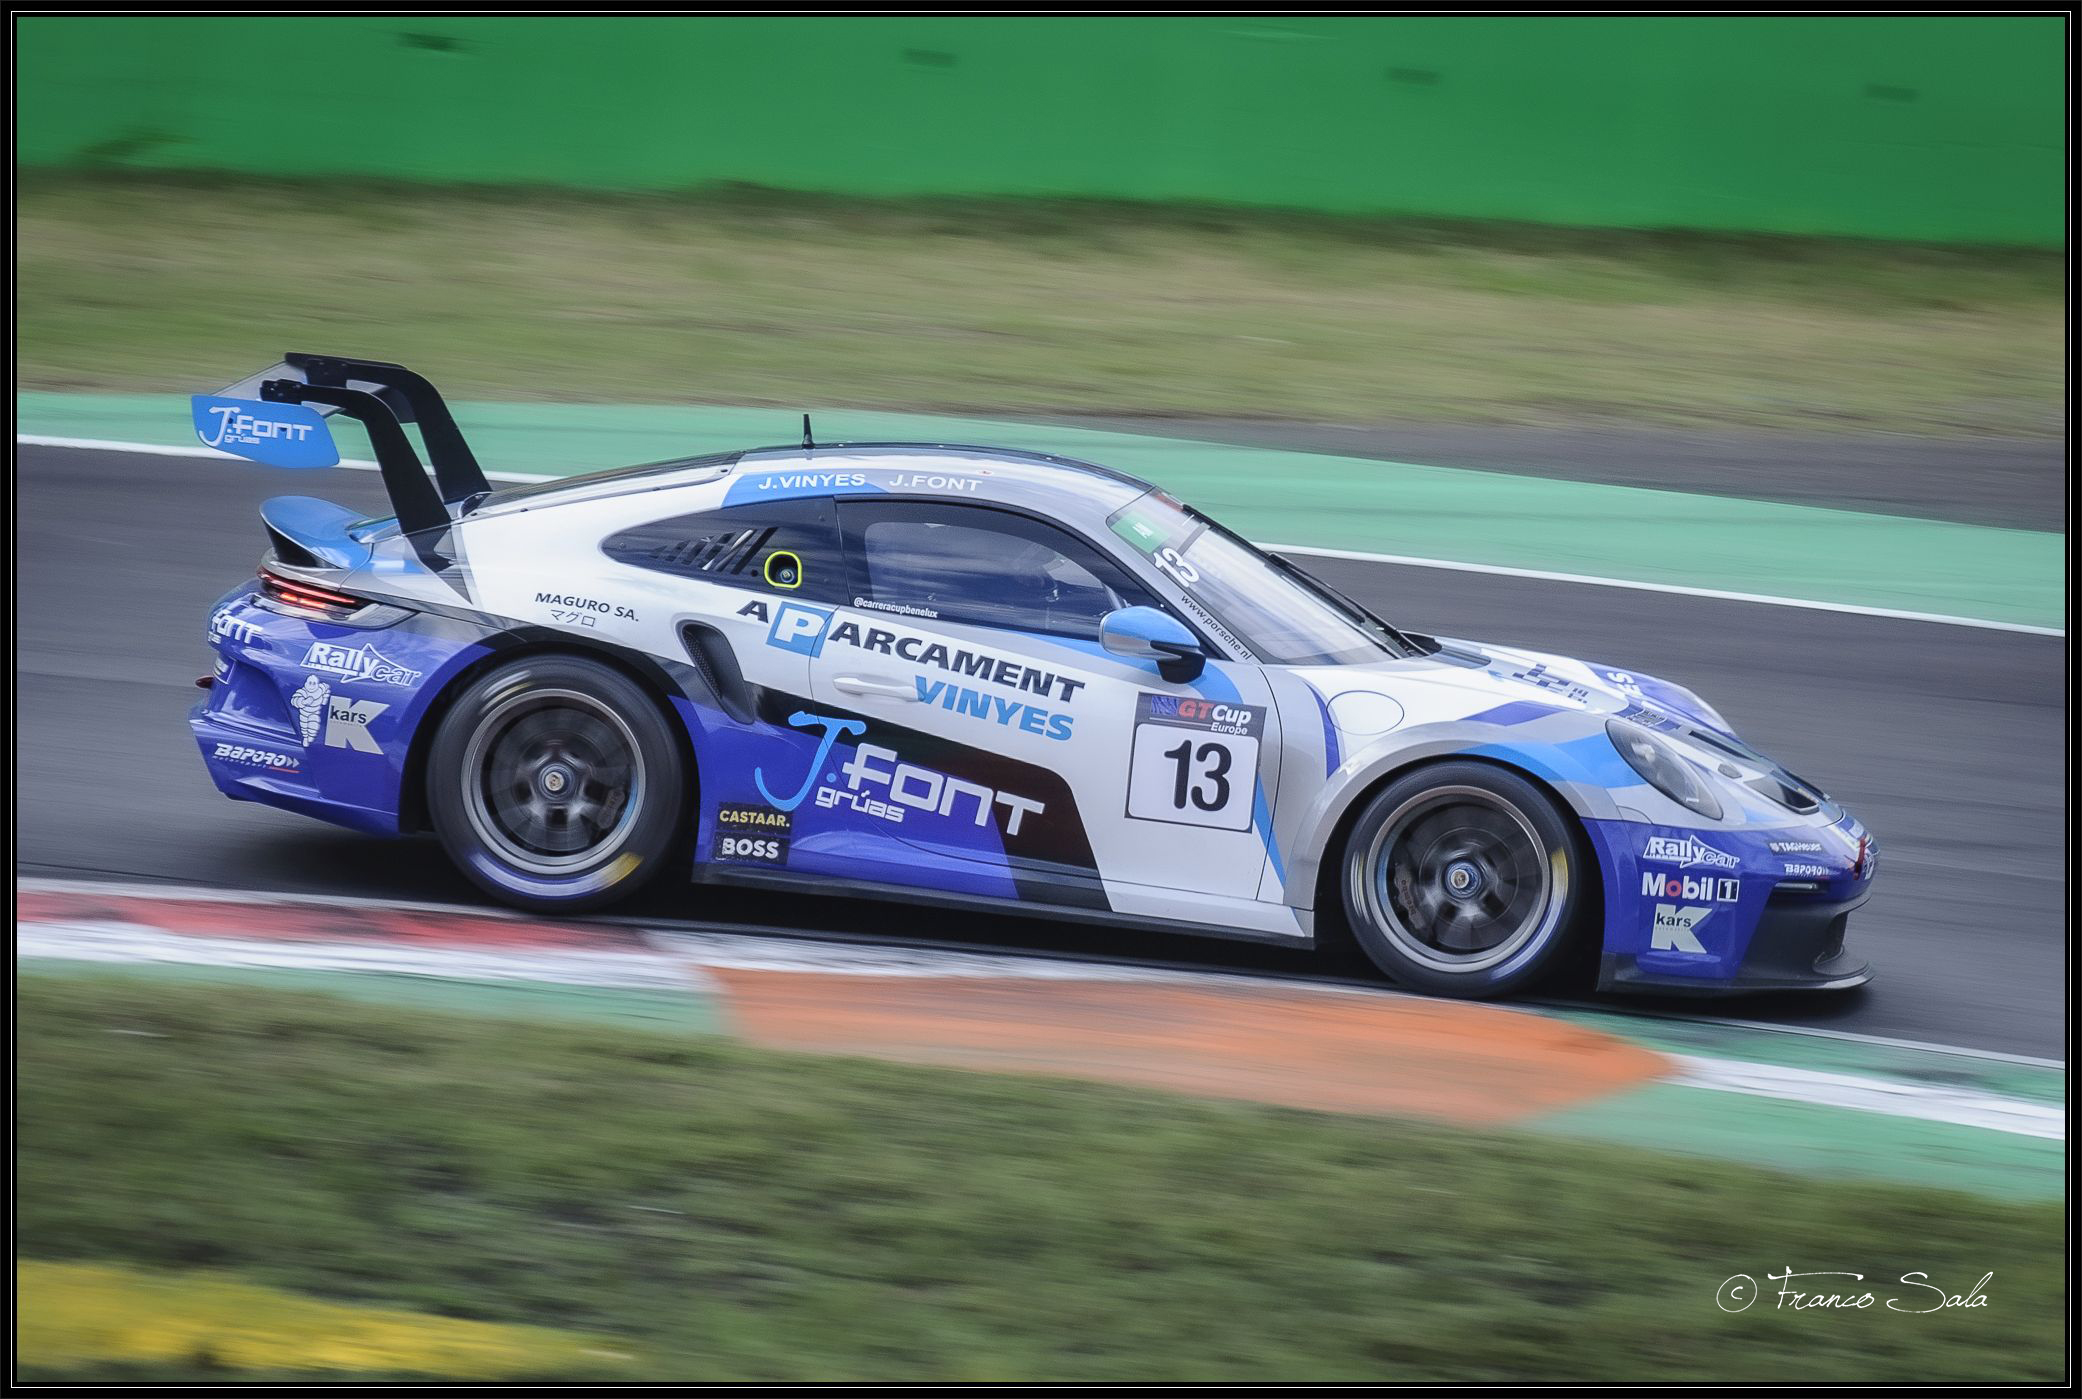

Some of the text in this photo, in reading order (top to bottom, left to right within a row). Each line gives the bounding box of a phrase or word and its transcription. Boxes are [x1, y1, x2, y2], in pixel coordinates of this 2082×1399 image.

[758, 473, 983, 492] J.VINYES J.FONT
[1154, 547, 1200, 588] 13
[535, 592, 639, 622] MAGURO SA.
[550, 608, 596, 628] マグロ
[853, 596, 939, 619] @carreracupbenelux
[1181, 595, 1253, 661] www.porsche.nl
[329, 705, 368, 725] kars
[914, 675, 1074, 742] VINYES
[1210, 721, 1248, 736] Europe
[1164, 739, 1232, 812] 13
[814, 789, 905, 823] grúas
[719, 810, 791, 828] CASTAAR.
[721, 838, 780, 860] BOSS
[1641, 871, 1714, 901] Mobil
[1655, 912, 1692, 928] kars
